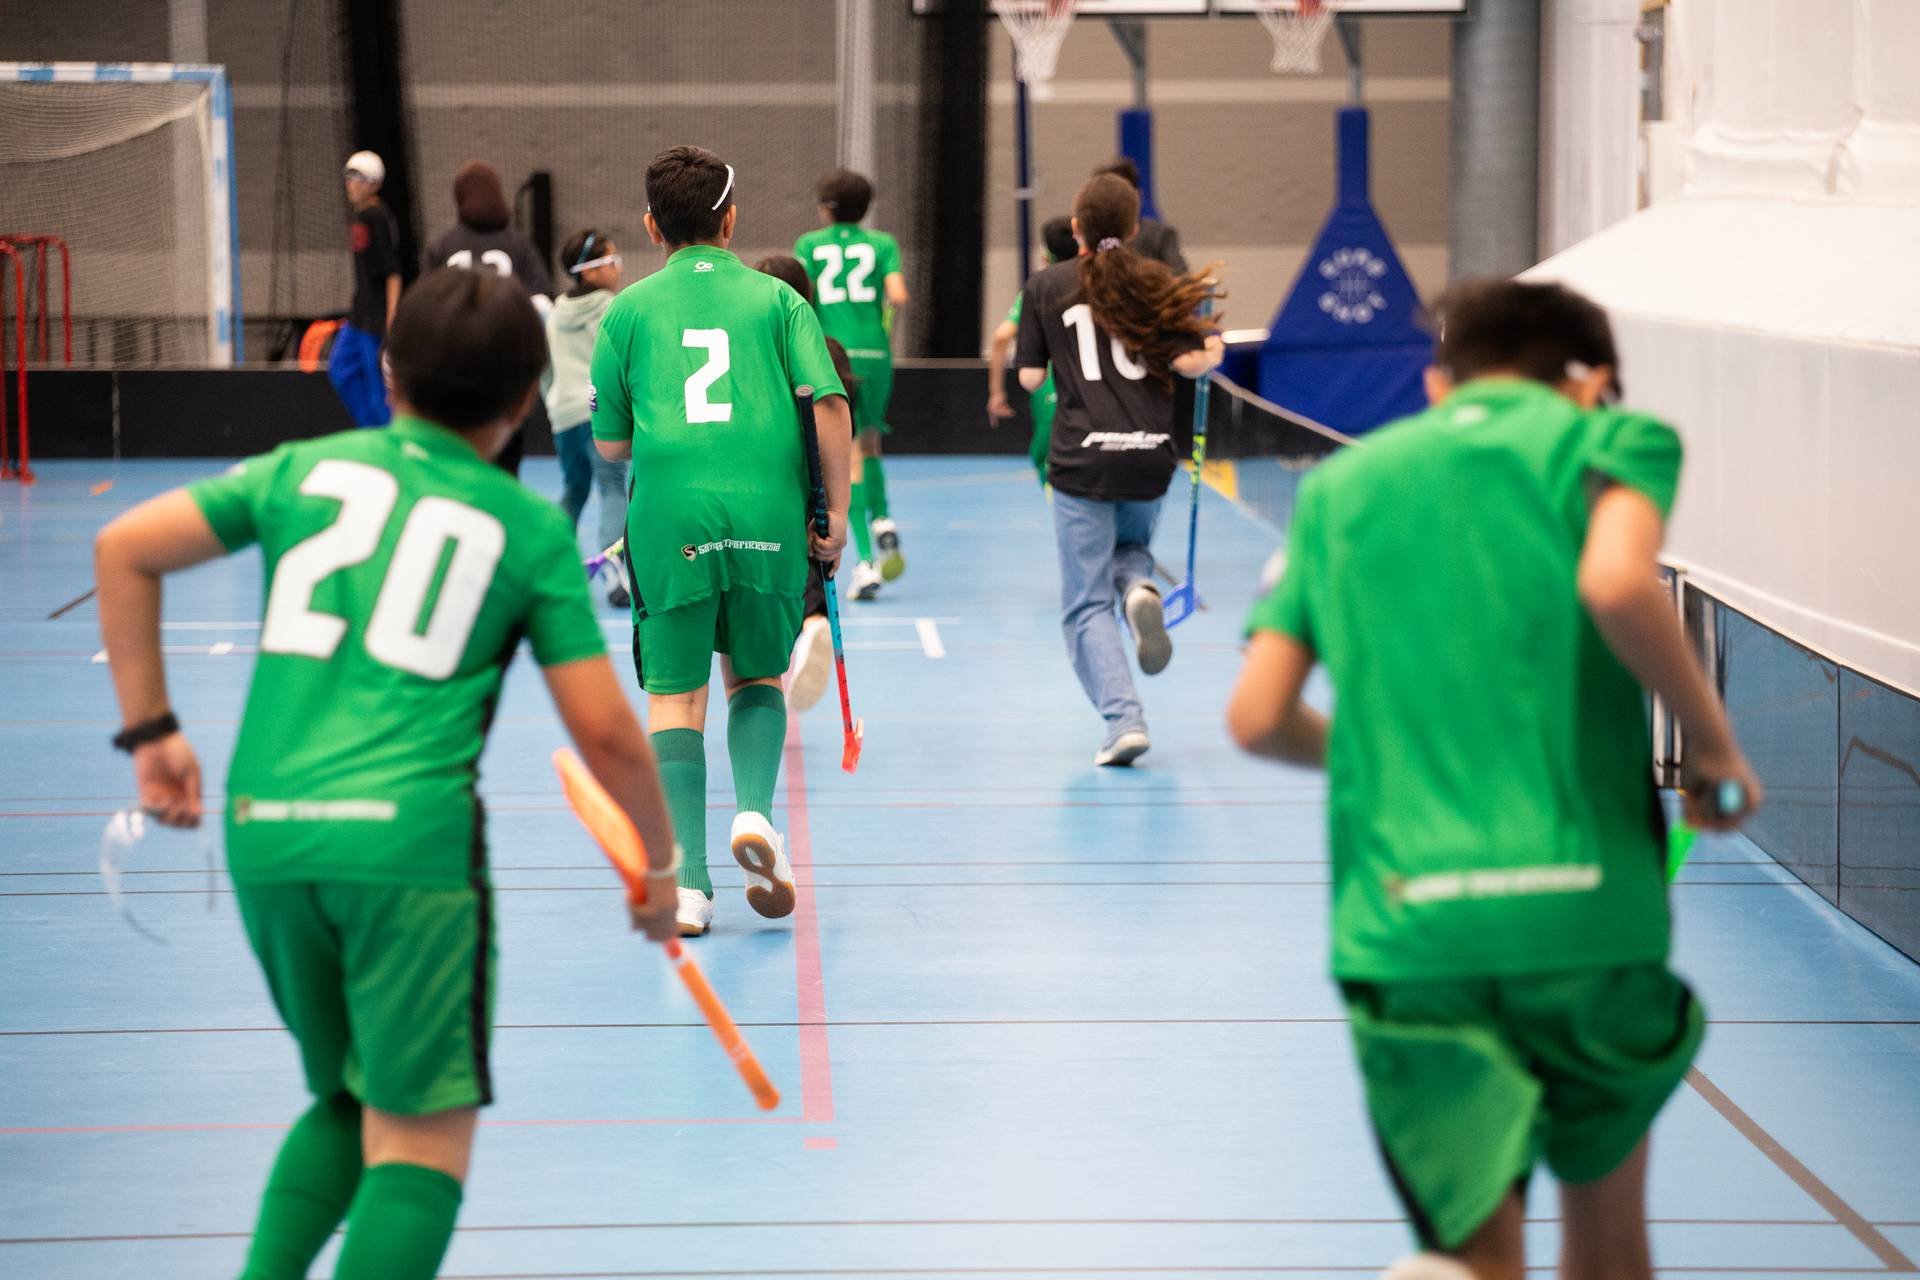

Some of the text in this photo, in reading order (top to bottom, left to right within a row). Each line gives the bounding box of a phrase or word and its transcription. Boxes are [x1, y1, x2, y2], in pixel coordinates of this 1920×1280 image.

[812, 242, 877, 304] 22
[681, 327, 733, 424] 2
[262, 458, 505, 680] 20
